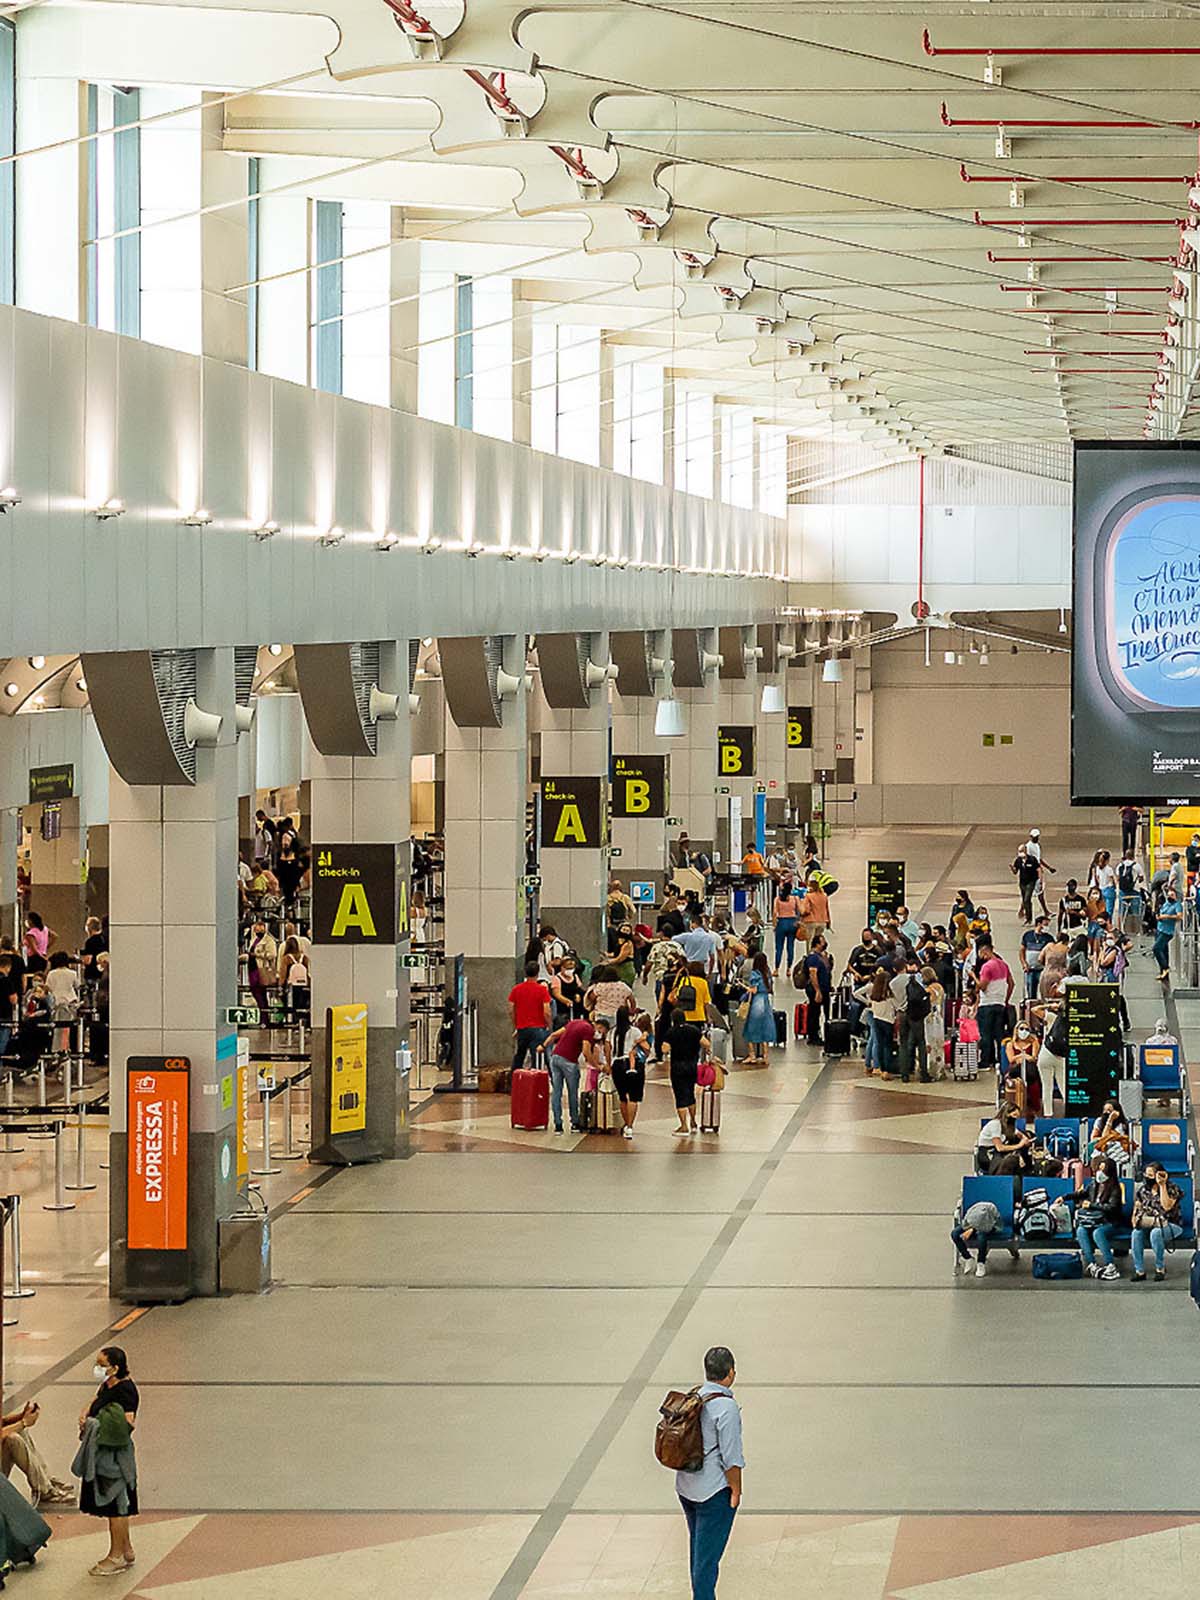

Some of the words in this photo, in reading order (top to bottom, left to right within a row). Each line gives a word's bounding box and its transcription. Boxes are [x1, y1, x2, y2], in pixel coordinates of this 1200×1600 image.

[786, 722, 803, 745] B
[722, 745, 742, 773] B
[626, 779, 650, 813] B
[553, 804, 587, 842] A
[318, 868, 360, 877] check-in
[331, 883, 377, 936] A
[164, 1058, 188, 1069] GOL
[145, 1101, 163, 1202] EXPRESSA
